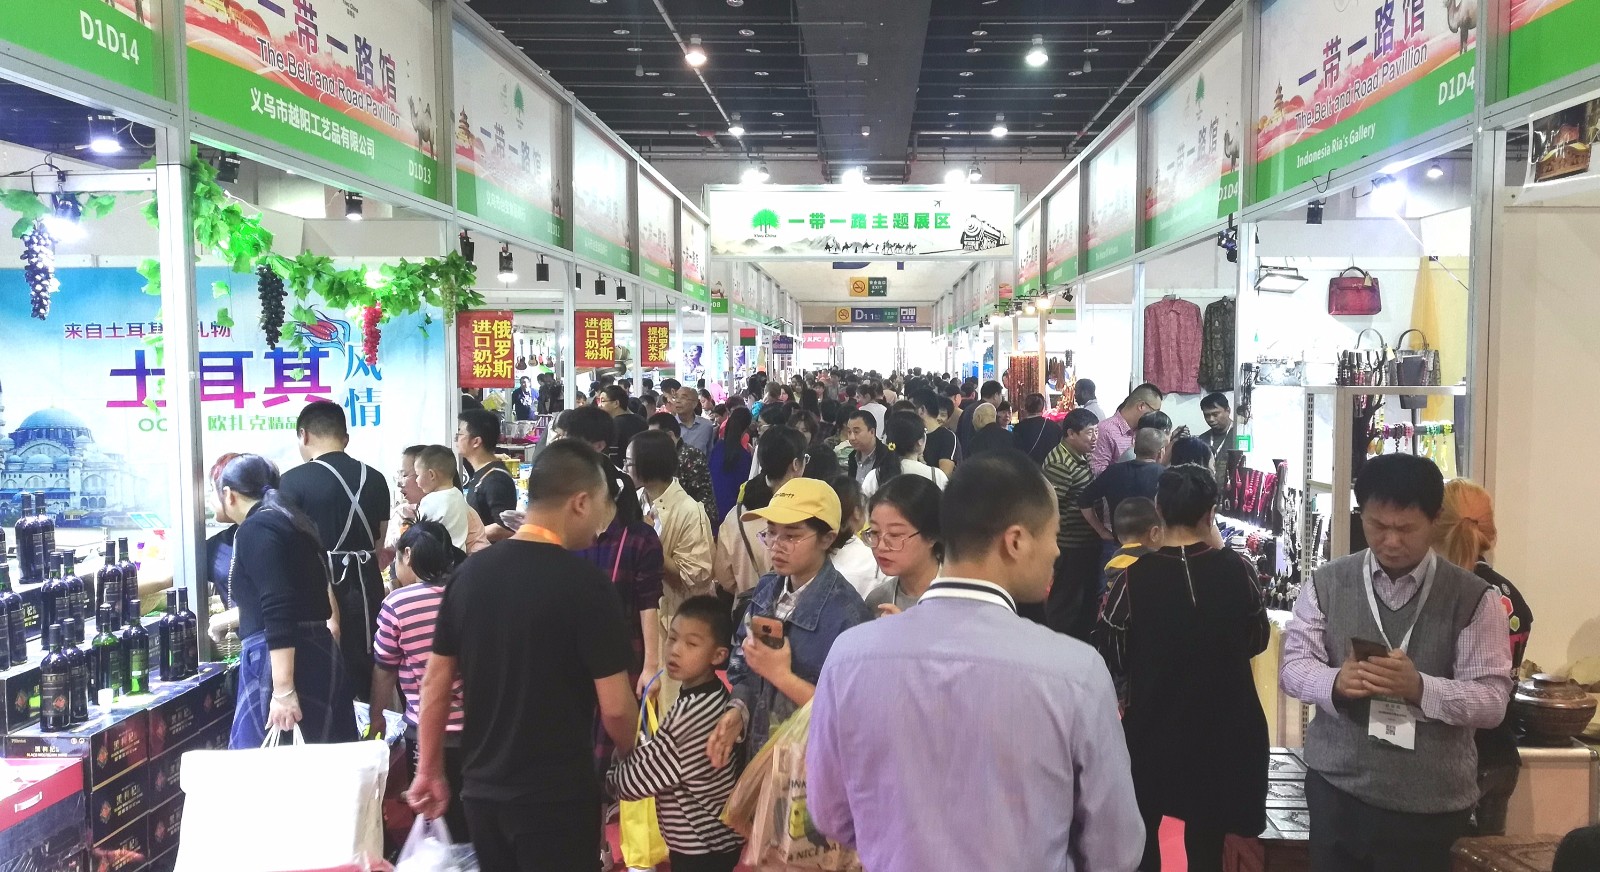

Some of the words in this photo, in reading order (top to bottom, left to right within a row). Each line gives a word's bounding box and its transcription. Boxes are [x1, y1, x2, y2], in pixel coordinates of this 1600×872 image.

[80, 10, 139, 65] D1D14
[257, 37, 284, 69] The
[288, 53, 313, 84] Belt
[315, 71, 335, 95] and
[337, 79, 364, 110] Road
[366, 93, 400, 128] Pavillion
[1295, 111, 1312, 130] The
[1314, 96, 1332, 122] Belt
[1334, 87, 1350, 110] and
[1353, 72, 1378, 100] Road
[1382, 43, 1428, 87] Pavillion
[250, 87, 375, 160] 义乌市越阳工艺品有限公司
[1297, 143, 1330, 168] Indonesia
[1331, 135, 1349, 154] Ria's
[1350, 123, 1375, 146] Gallery
[408, 159, 432, 185] D1D13
[788, 212, 950, 229] 一带一路主题展区
[472, 319, 492, 378] 进口奶粉
[492, 319, 513, 379] 俄罗斯
[584, 318, 599, 361] 进口奶粉
[599, 318, 613, 361] 俄罗斯
[647, 326, 658, 361] 提拉米苏
[658, 326, 669, 361] 俄罗斯
[106, 346, 332, 409] 土耳其
